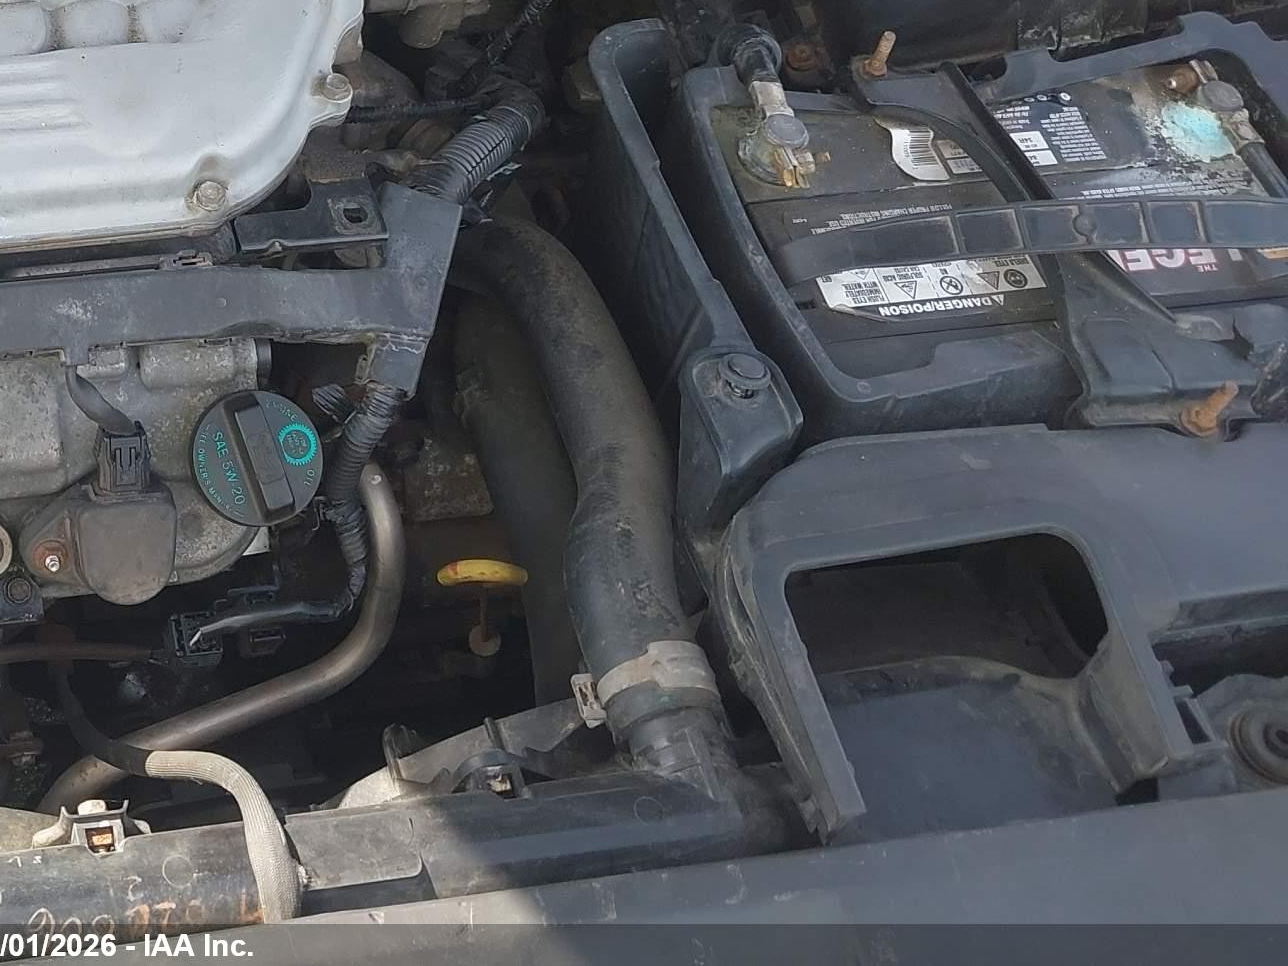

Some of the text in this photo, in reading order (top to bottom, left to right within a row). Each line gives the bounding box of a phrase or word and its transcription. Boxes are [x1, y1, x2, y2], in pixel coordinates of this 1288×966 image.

[1196, 264, 1219, 274] THE
[878, 295, 993, 317] DANGER/POISON
[213, 431, 230, 459] SAE
